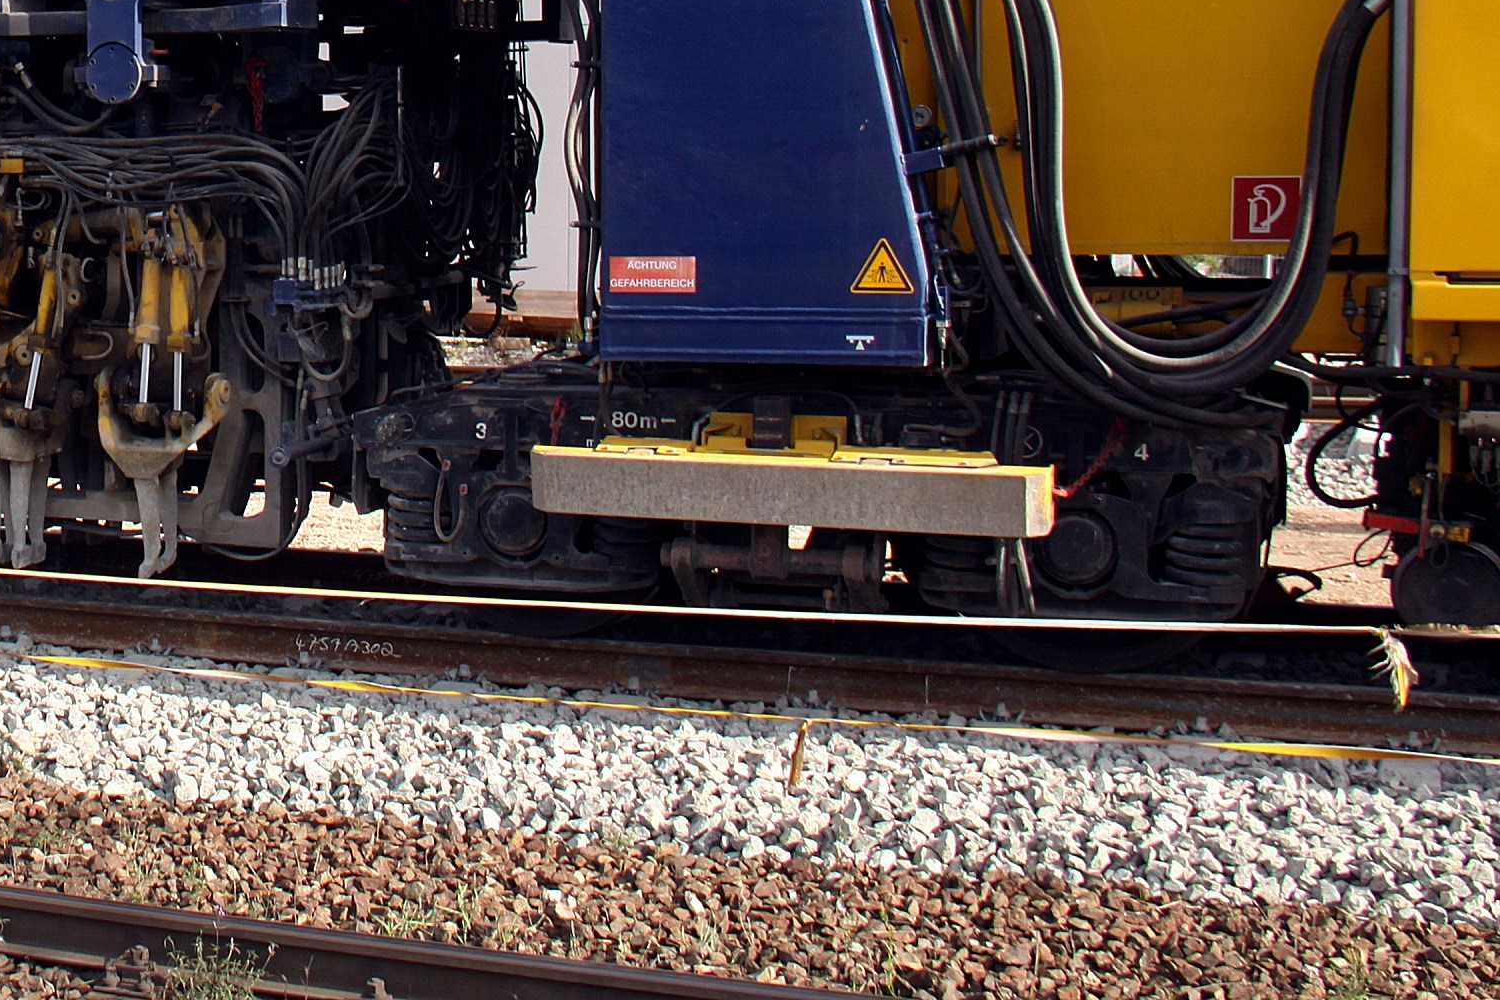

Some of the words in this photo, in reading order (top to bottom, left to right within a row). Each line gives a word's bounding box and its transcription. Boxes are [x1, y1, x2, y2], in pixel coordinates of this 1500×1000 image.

[626, 260, 677, 270] ACHTUNG
[609, 278, 695, 288] GEFAHRBEREICH
[475, 422, 487, 440] 3
[1133, 442, 1150, 462] 4
